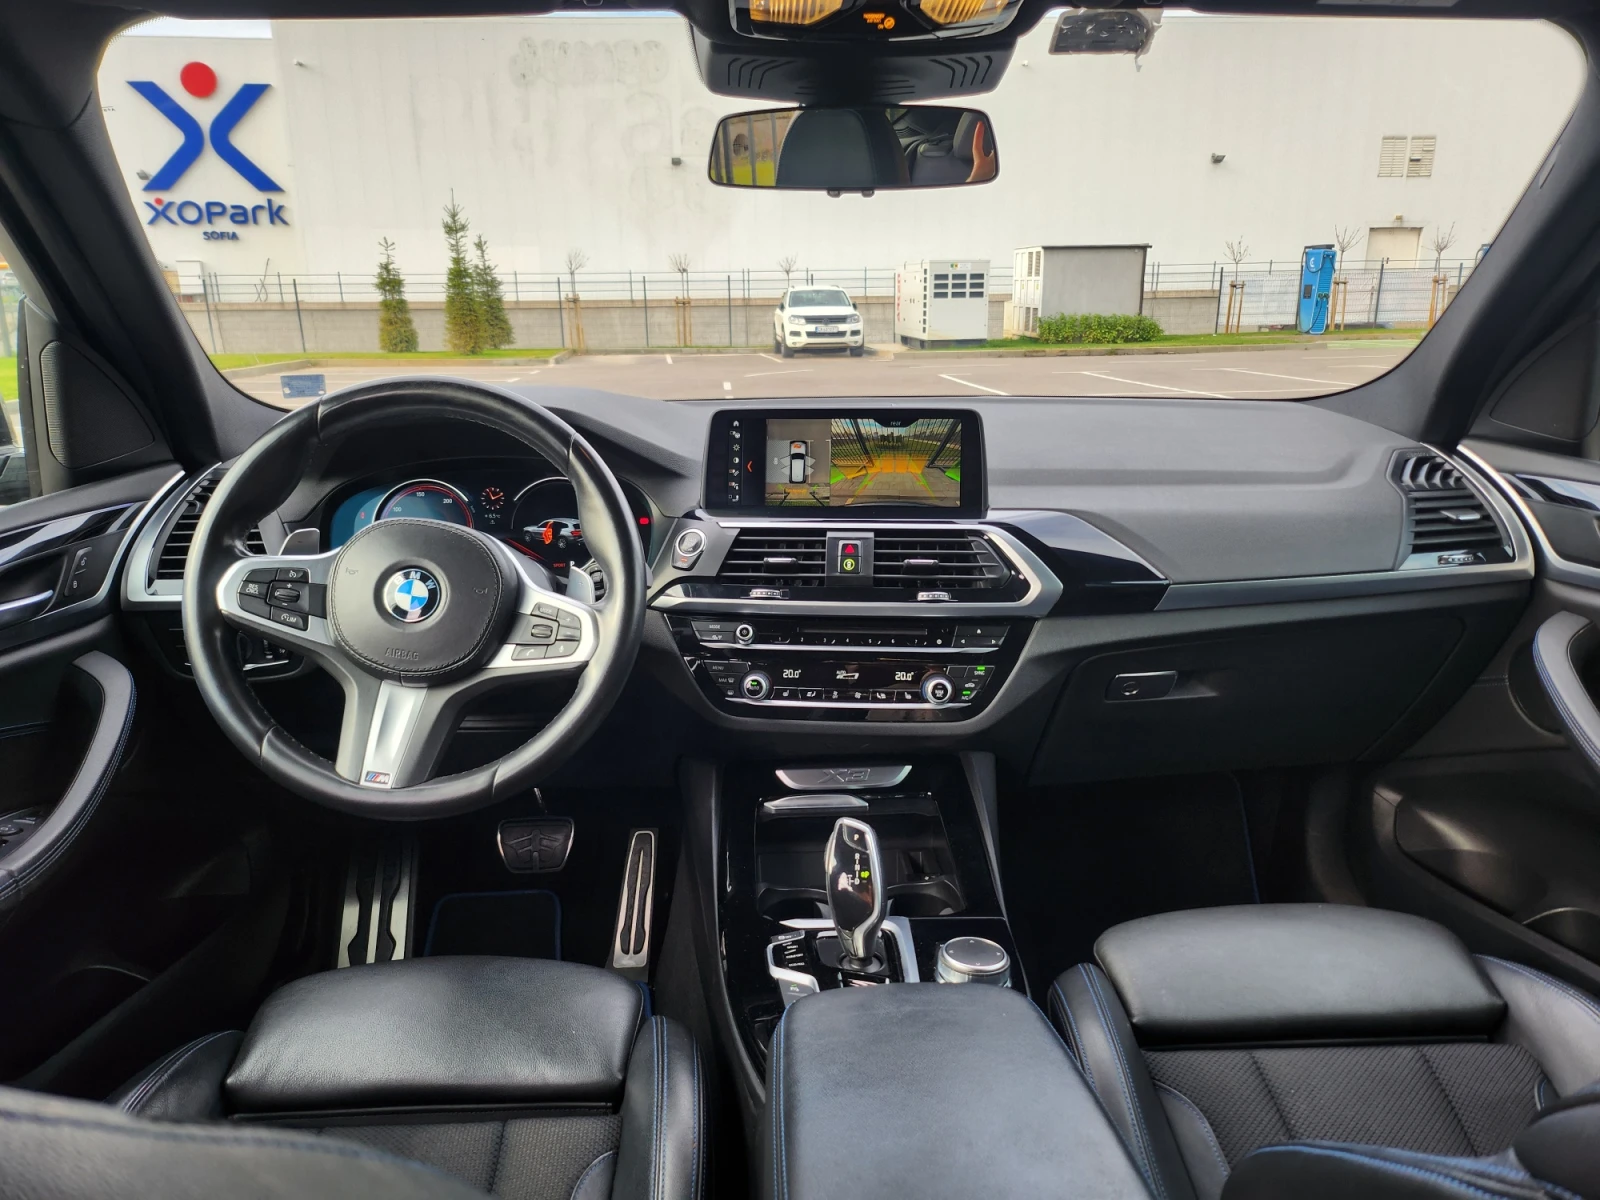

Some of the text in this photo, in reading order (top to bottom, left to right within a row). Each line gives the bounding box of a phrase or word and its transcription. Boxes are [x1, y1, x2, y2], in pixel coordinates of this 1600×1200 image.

[143, 198, 290, 226] XOPark
[203, 231, 239, 241] SOFIA
[394, 570, 437, 590] BMW
[385, 647, 419, 660] AIRBAG
[818, 768, 871, 783] X3
[853, 833, 860, 841] P
